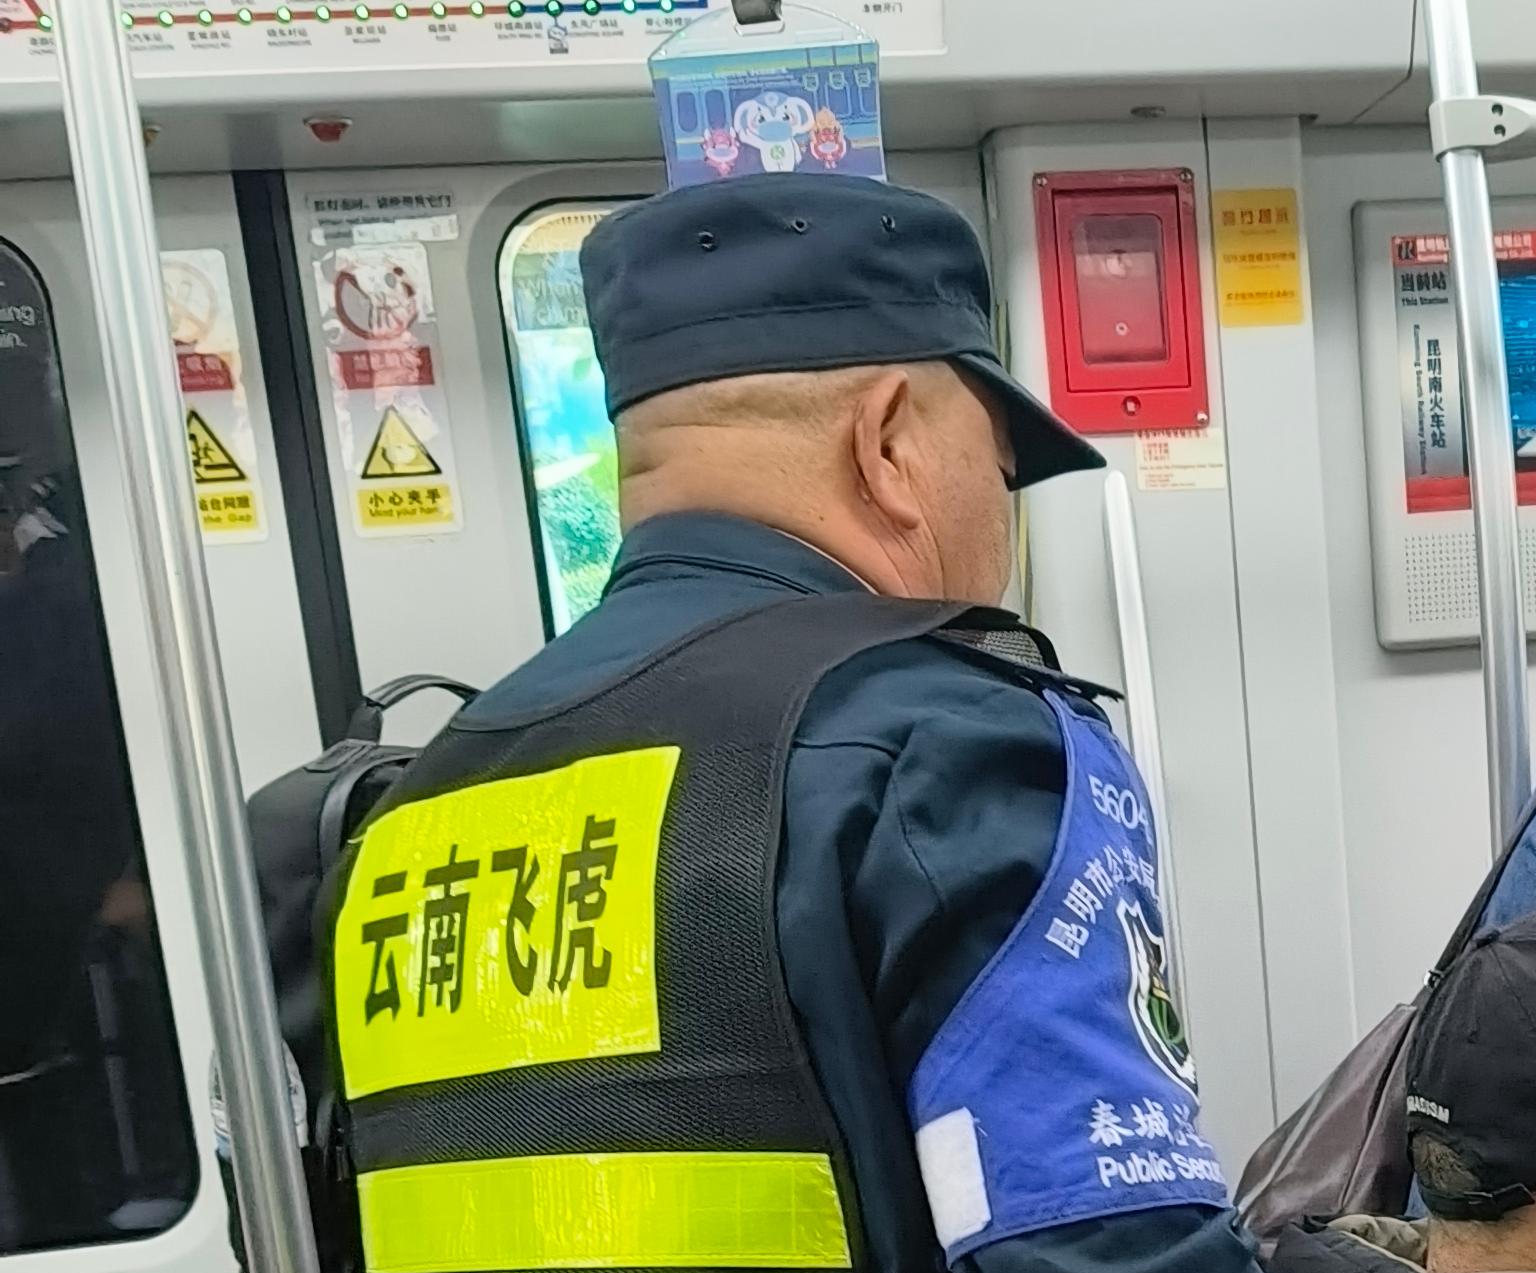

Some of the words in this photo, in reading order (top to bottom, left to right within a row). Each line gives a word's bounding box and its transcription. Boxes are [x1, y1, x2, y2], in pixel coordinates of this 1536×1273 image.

[1427, 339, 1447, 448] 昆明南火车站
[361, 814, 619, 1026] 云南飞虎
[1045, 844, 1160, 959] 昆明市公安局
[1097, 1151, 1176, 1188] Public
